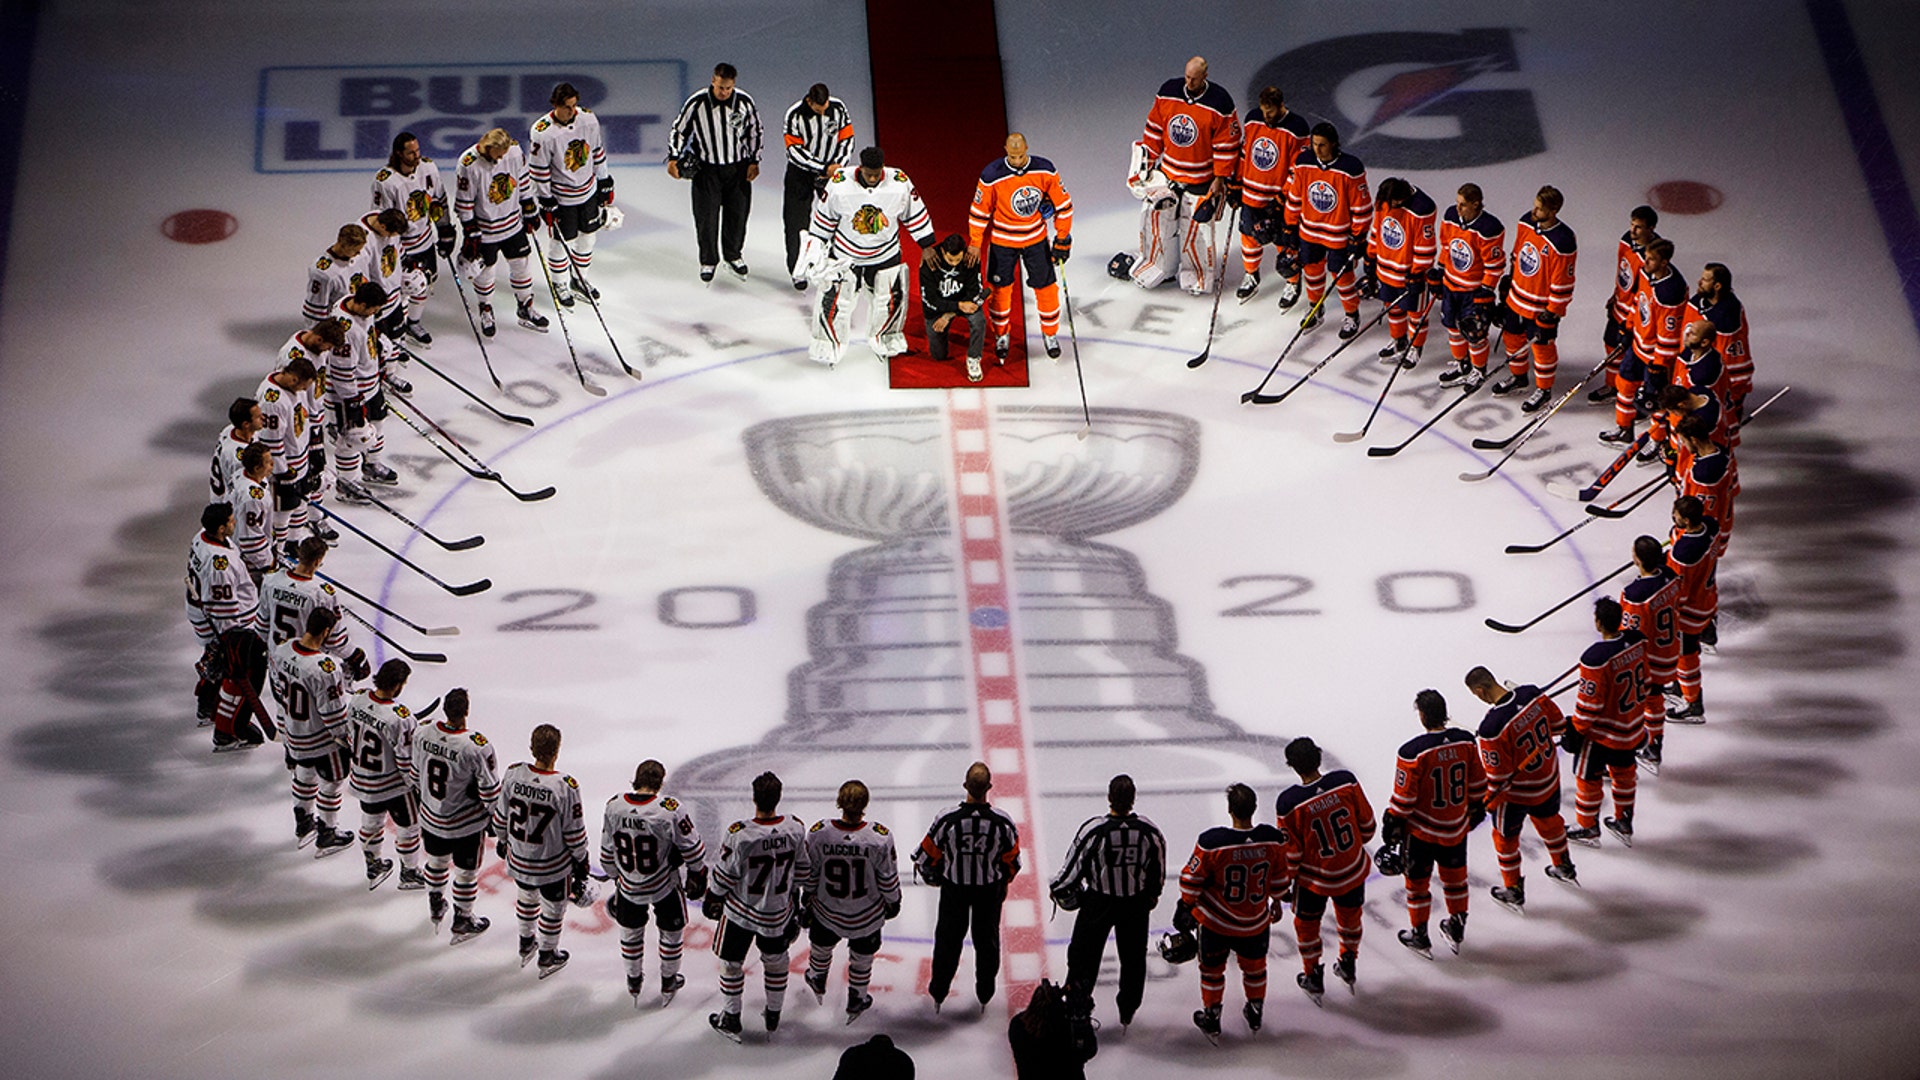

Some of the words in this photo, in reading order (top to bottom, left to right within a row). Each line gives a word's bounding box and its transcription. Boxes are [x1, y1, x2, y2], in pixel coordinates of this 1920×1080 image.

[339, 72, 608, 117] BUD
[1726, 340, 1745, 357] 41
[1600, 441, 1640, 486] CCM
[272, 587, 308, 608] MURPHY
[272, 604, 300, 645] 5
[350, 719, 385, 773] 12
[1437, 748, 1459, 762] NEAL
[1516, 716, 1552, 773] 39
[427, 758, 450, 800] 8
[1431, 761, 1467, 809] 18
[509, 797, 557, 845] 27
[961, 834, 988, 852] 34
[1311, 807, 1354, 858] 16
[613, 830, 660, 875] 88
[748, 850, 796, 895] 77
[1111, 848, 1138, 865] 79
[823, 858, 869, 899] 91
[1223, 861, 1271, 905] 83
